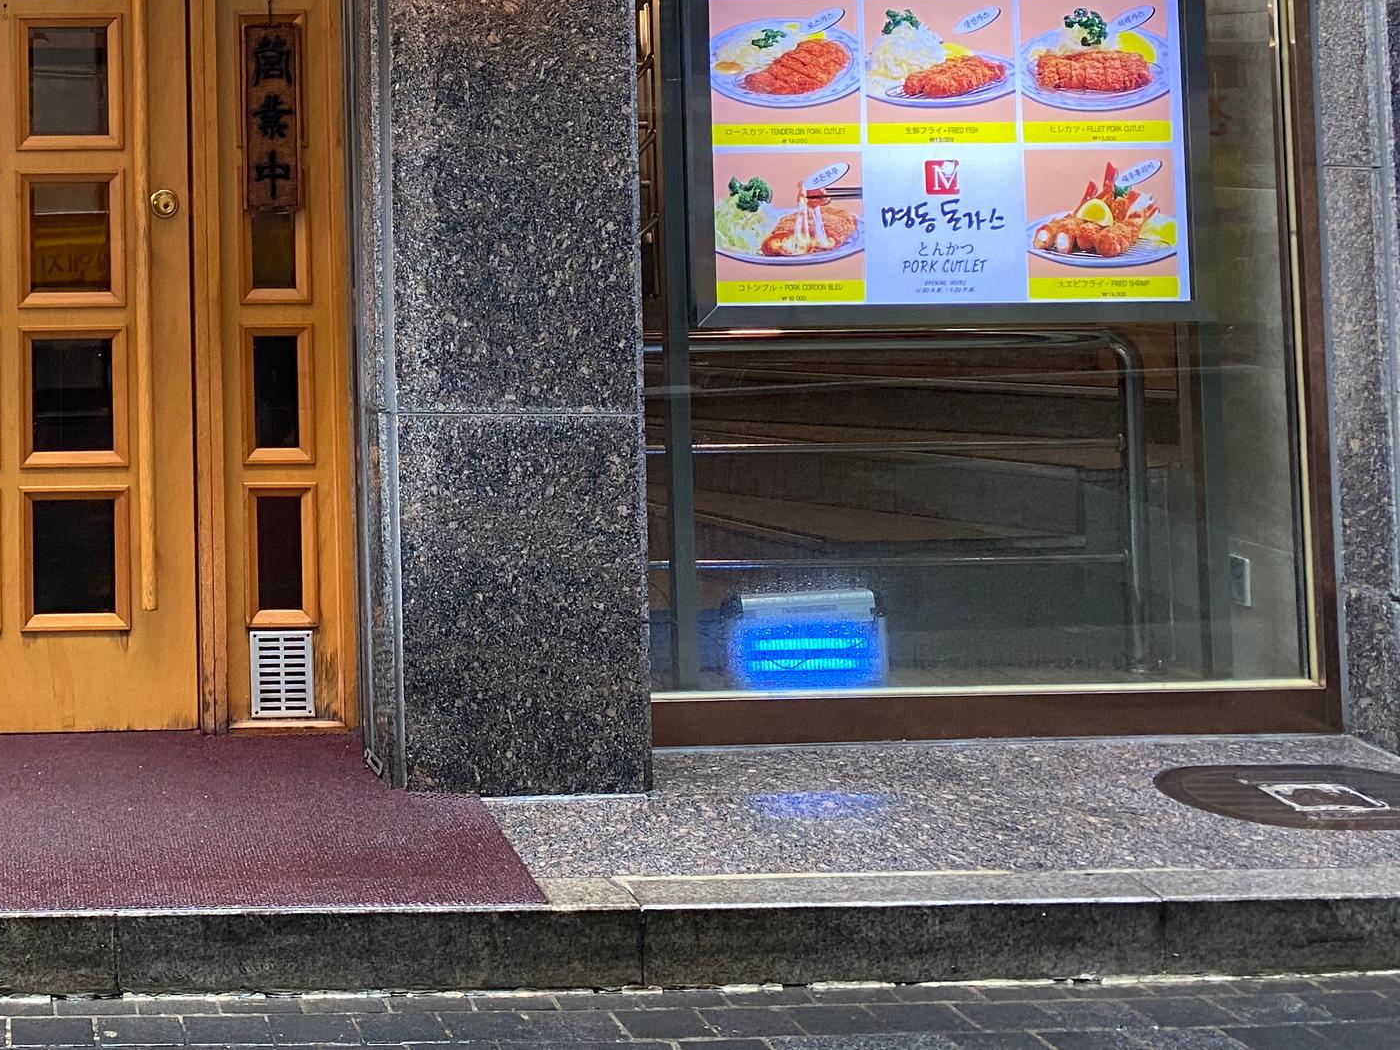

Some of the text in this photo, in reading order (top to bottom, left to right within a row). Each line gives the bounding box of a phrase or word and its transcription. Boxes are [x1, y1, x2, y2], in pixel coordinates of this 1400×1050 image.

[918, 241, 974, 256] とんかつ
[903, 259, 988, 273] PORK CUTLET
